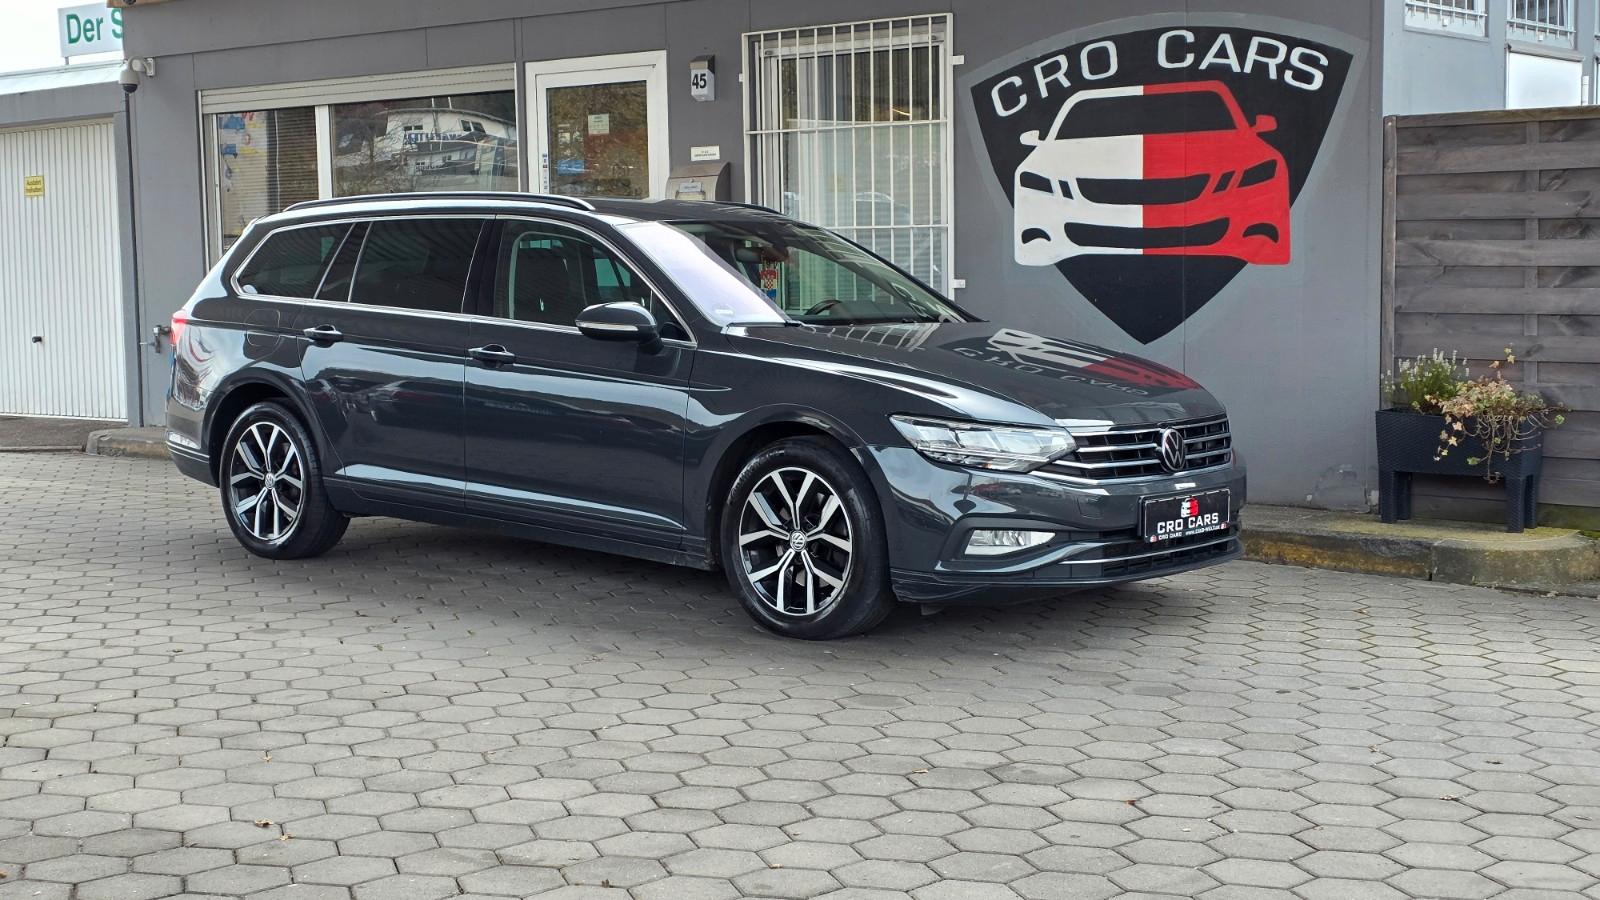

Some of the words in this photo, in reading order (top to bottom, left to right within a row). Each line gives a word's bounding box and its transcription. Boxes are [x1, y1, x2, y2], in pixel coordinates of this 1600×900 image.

[66, 13, 104, 44] Der
[692, 73, 707, 89] 45
[991, 40, 1118, 117] CRO
[1157, 29, 1329, 91] CARS
[1157, 519, 1183, 534] CRO
[1188, 512, 1219, 529] CARS
